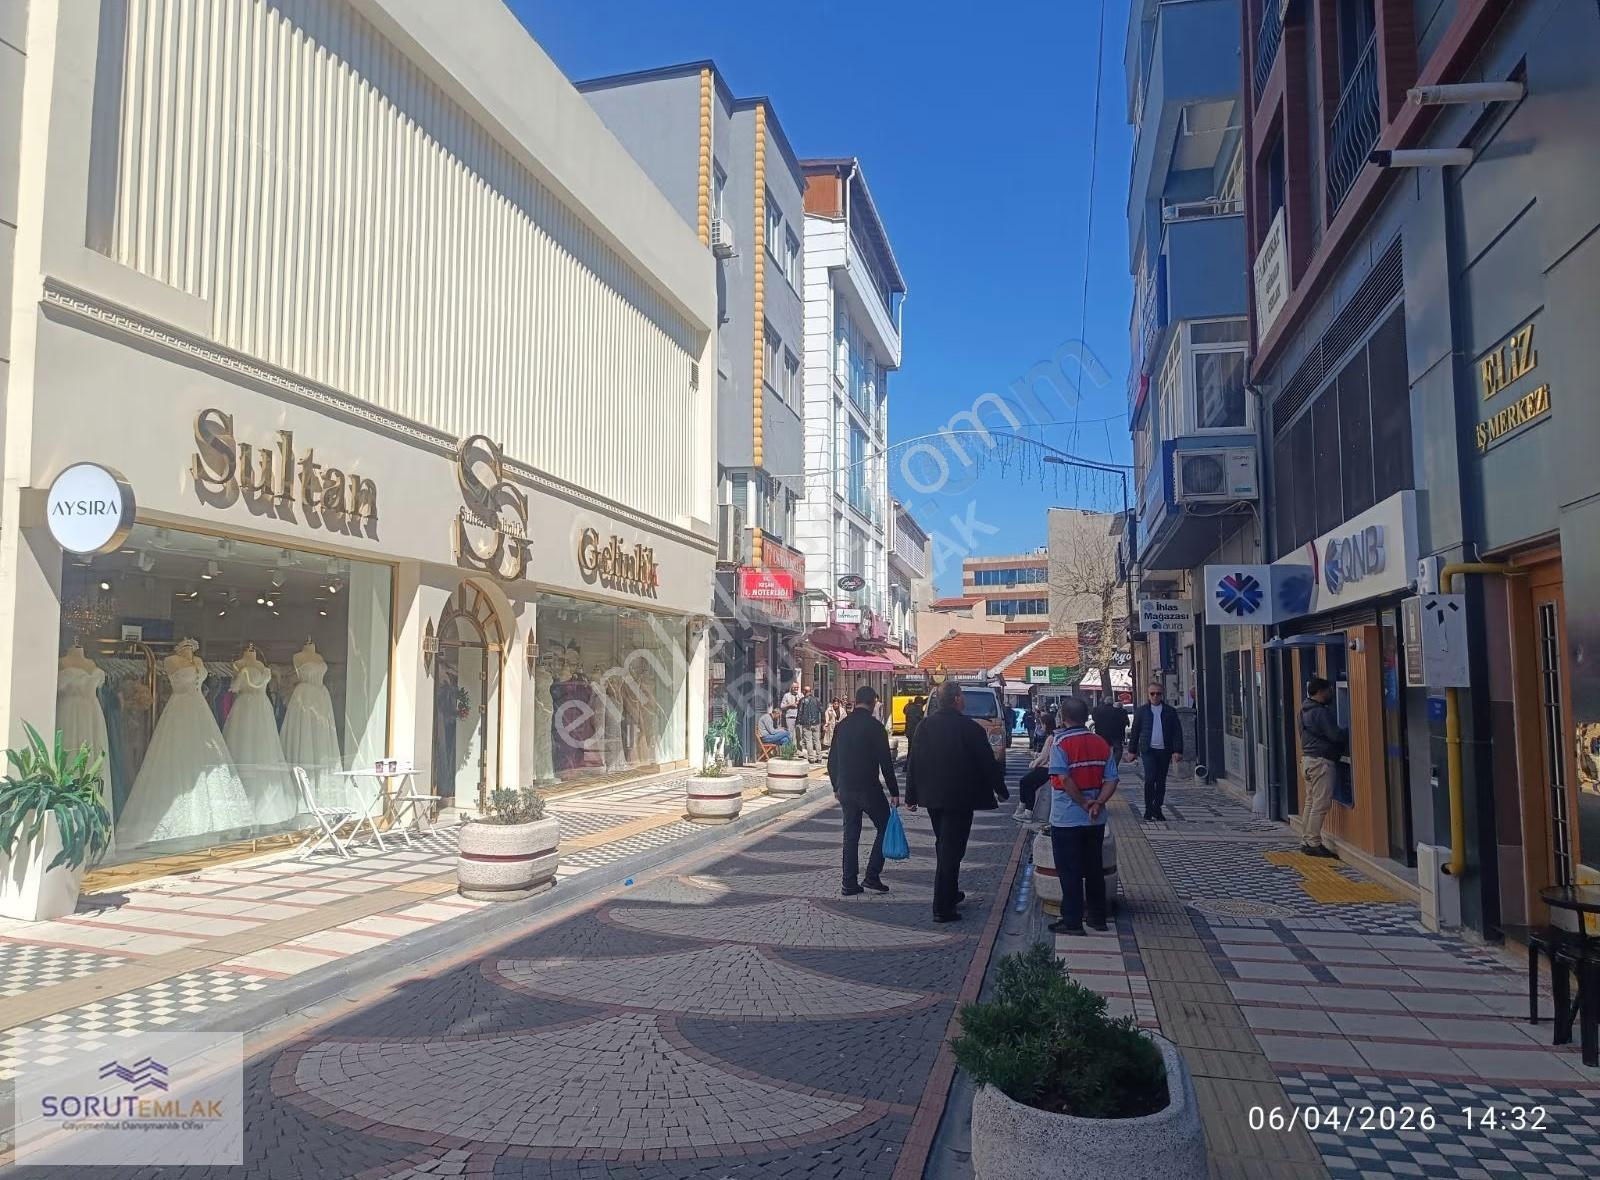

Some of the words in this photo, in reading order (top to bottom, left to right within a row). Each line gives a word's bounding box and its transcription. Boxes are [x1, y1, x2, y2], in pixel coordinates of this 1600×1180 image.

[190, 408, 379, 521] Sultan
[52, 500, 118, 516] AYSIRA
[578, 527, 660, 587] Gelinlik
[1340, 525, 1385, 583] QNB
[1156, 602, 1178, 611] İhlas
[1144, 612, 1189, 621] Mağazası
[1032, 669, 1047, 677] HDI
